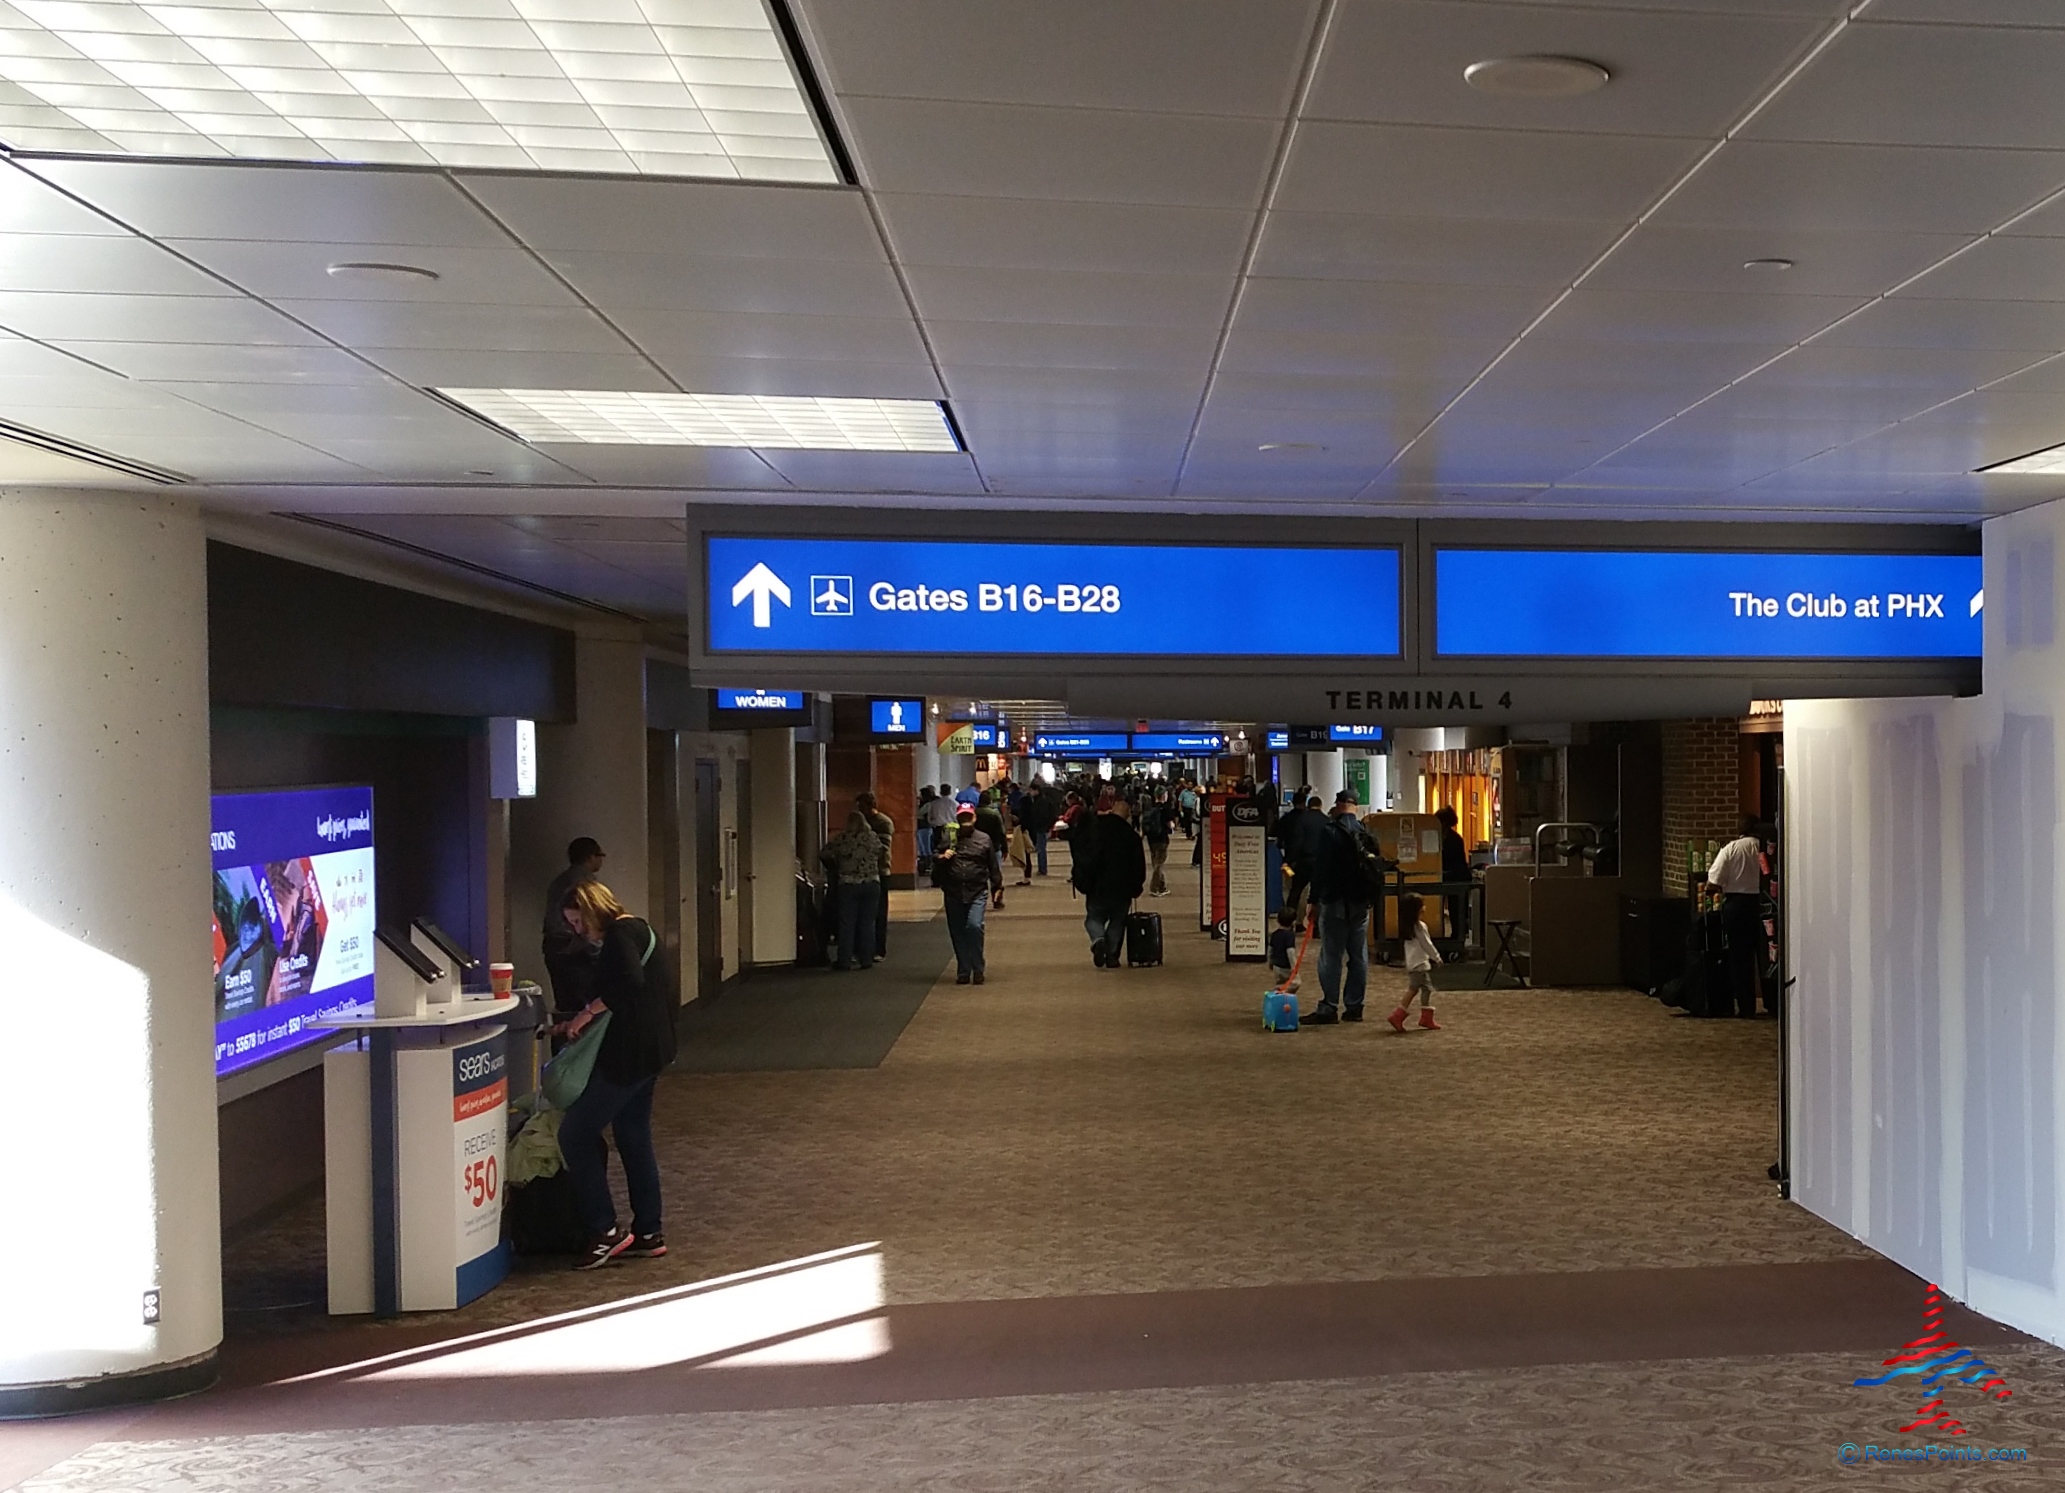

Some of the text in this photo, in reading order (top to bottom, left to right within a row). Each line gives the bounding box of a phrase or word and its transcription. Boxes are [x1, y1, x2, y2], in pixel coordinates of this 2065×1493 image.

[868, 582, 1121, 613] Gates B16-B28
[1729, 592, 1944, 618] The Club at PHX
[735, 696, 787, 708] WOMEN
[1325, 691, 1512, 710] TERMINAL 4
[887, 724, 906, 732] MEN
[950, 736, 972, 744] EARTH
[950, 744, 972, 752] SPIRIT
[459, 1052, 491, 1082] sears
[464, 1128, 497, 1158] RECEIVE
[464, 1155, 498, 1208] $50
